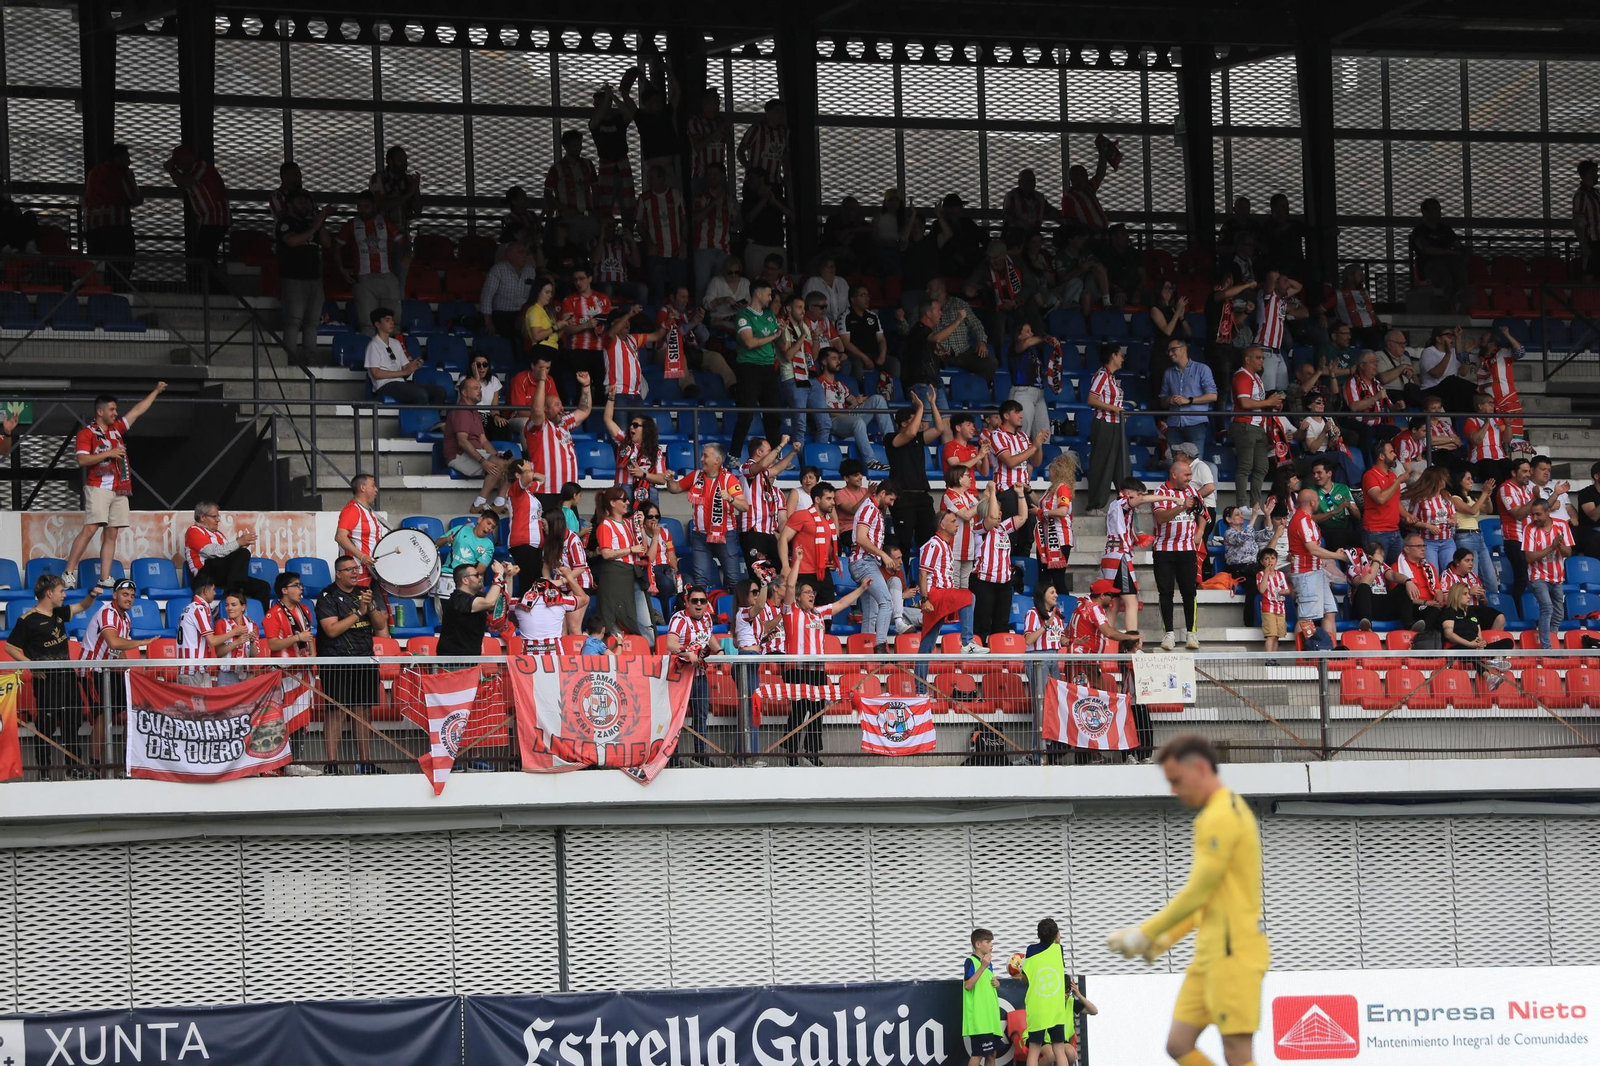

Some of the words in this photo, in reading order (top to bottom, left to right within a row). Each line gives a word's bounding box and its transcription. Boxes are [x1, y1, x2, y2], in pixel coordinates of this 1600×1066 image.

[1552, 432, 1569, 441] FILA
[571, 673, 595, 704] SIEMPRE
[595, 674, 629, 706] AMANECE
[136, 709, 252, 741] GUARDIANES
[596, 714, 627, 738] ZAMORA
[147, 735, 181, 761] DEL
[185, 737, 245, 764] DUERO
[1366, 1003, 1496, 1027] Empresa
[1507, 1001, 1587, 1021] Nieto
[44, 1022, 210, 1066] XUNTA
[522, 1014, 736, 1066] Estrella
[751, 1003, 948, 1066] Galicia
[1366, 1034, 1450, 1048] Mantenimiento
[1452, 1033, 1494, 1048] Integral
[1497, 1033, 1511, 1046] de
[1513, 1032, 1589, 1046] Comunidades
